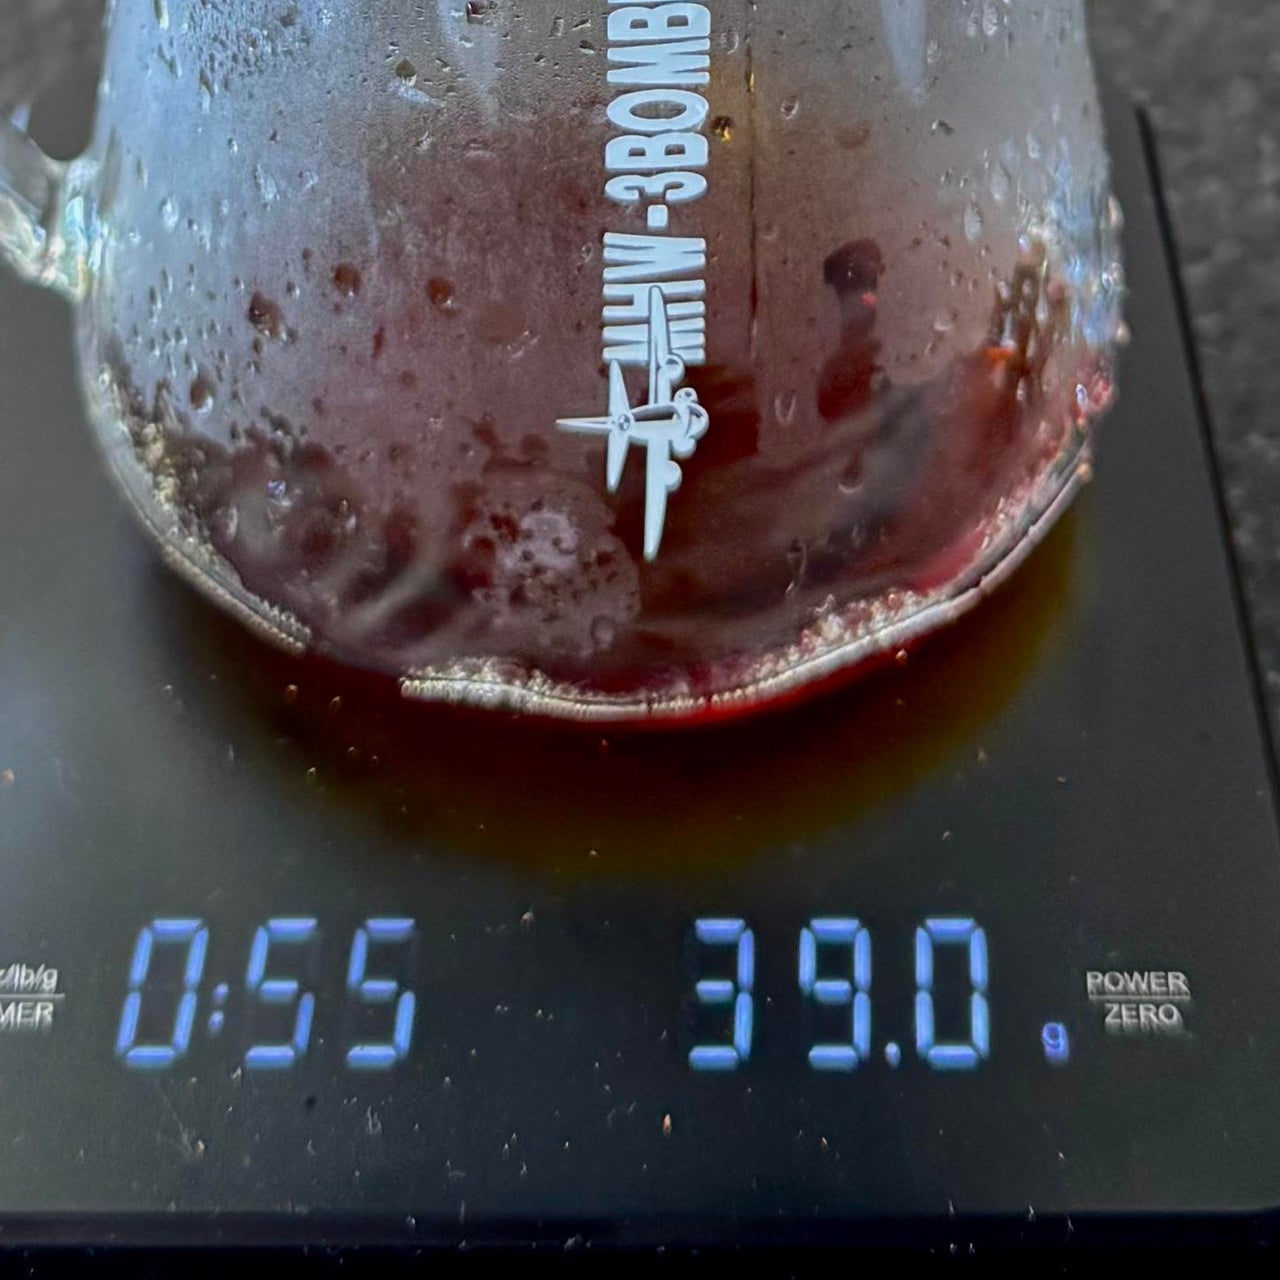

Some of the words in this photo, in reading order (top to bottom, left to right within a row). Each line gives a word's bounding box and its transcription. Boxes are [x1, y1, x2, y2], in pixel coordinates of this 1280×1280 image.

[116, 917, 418, 1068] 0:55
[687, 917, 991, 1069] 39.0
[1086, 970, 1191, 997] POWER
[1104, 1003, 1183, 1030] ZERO
